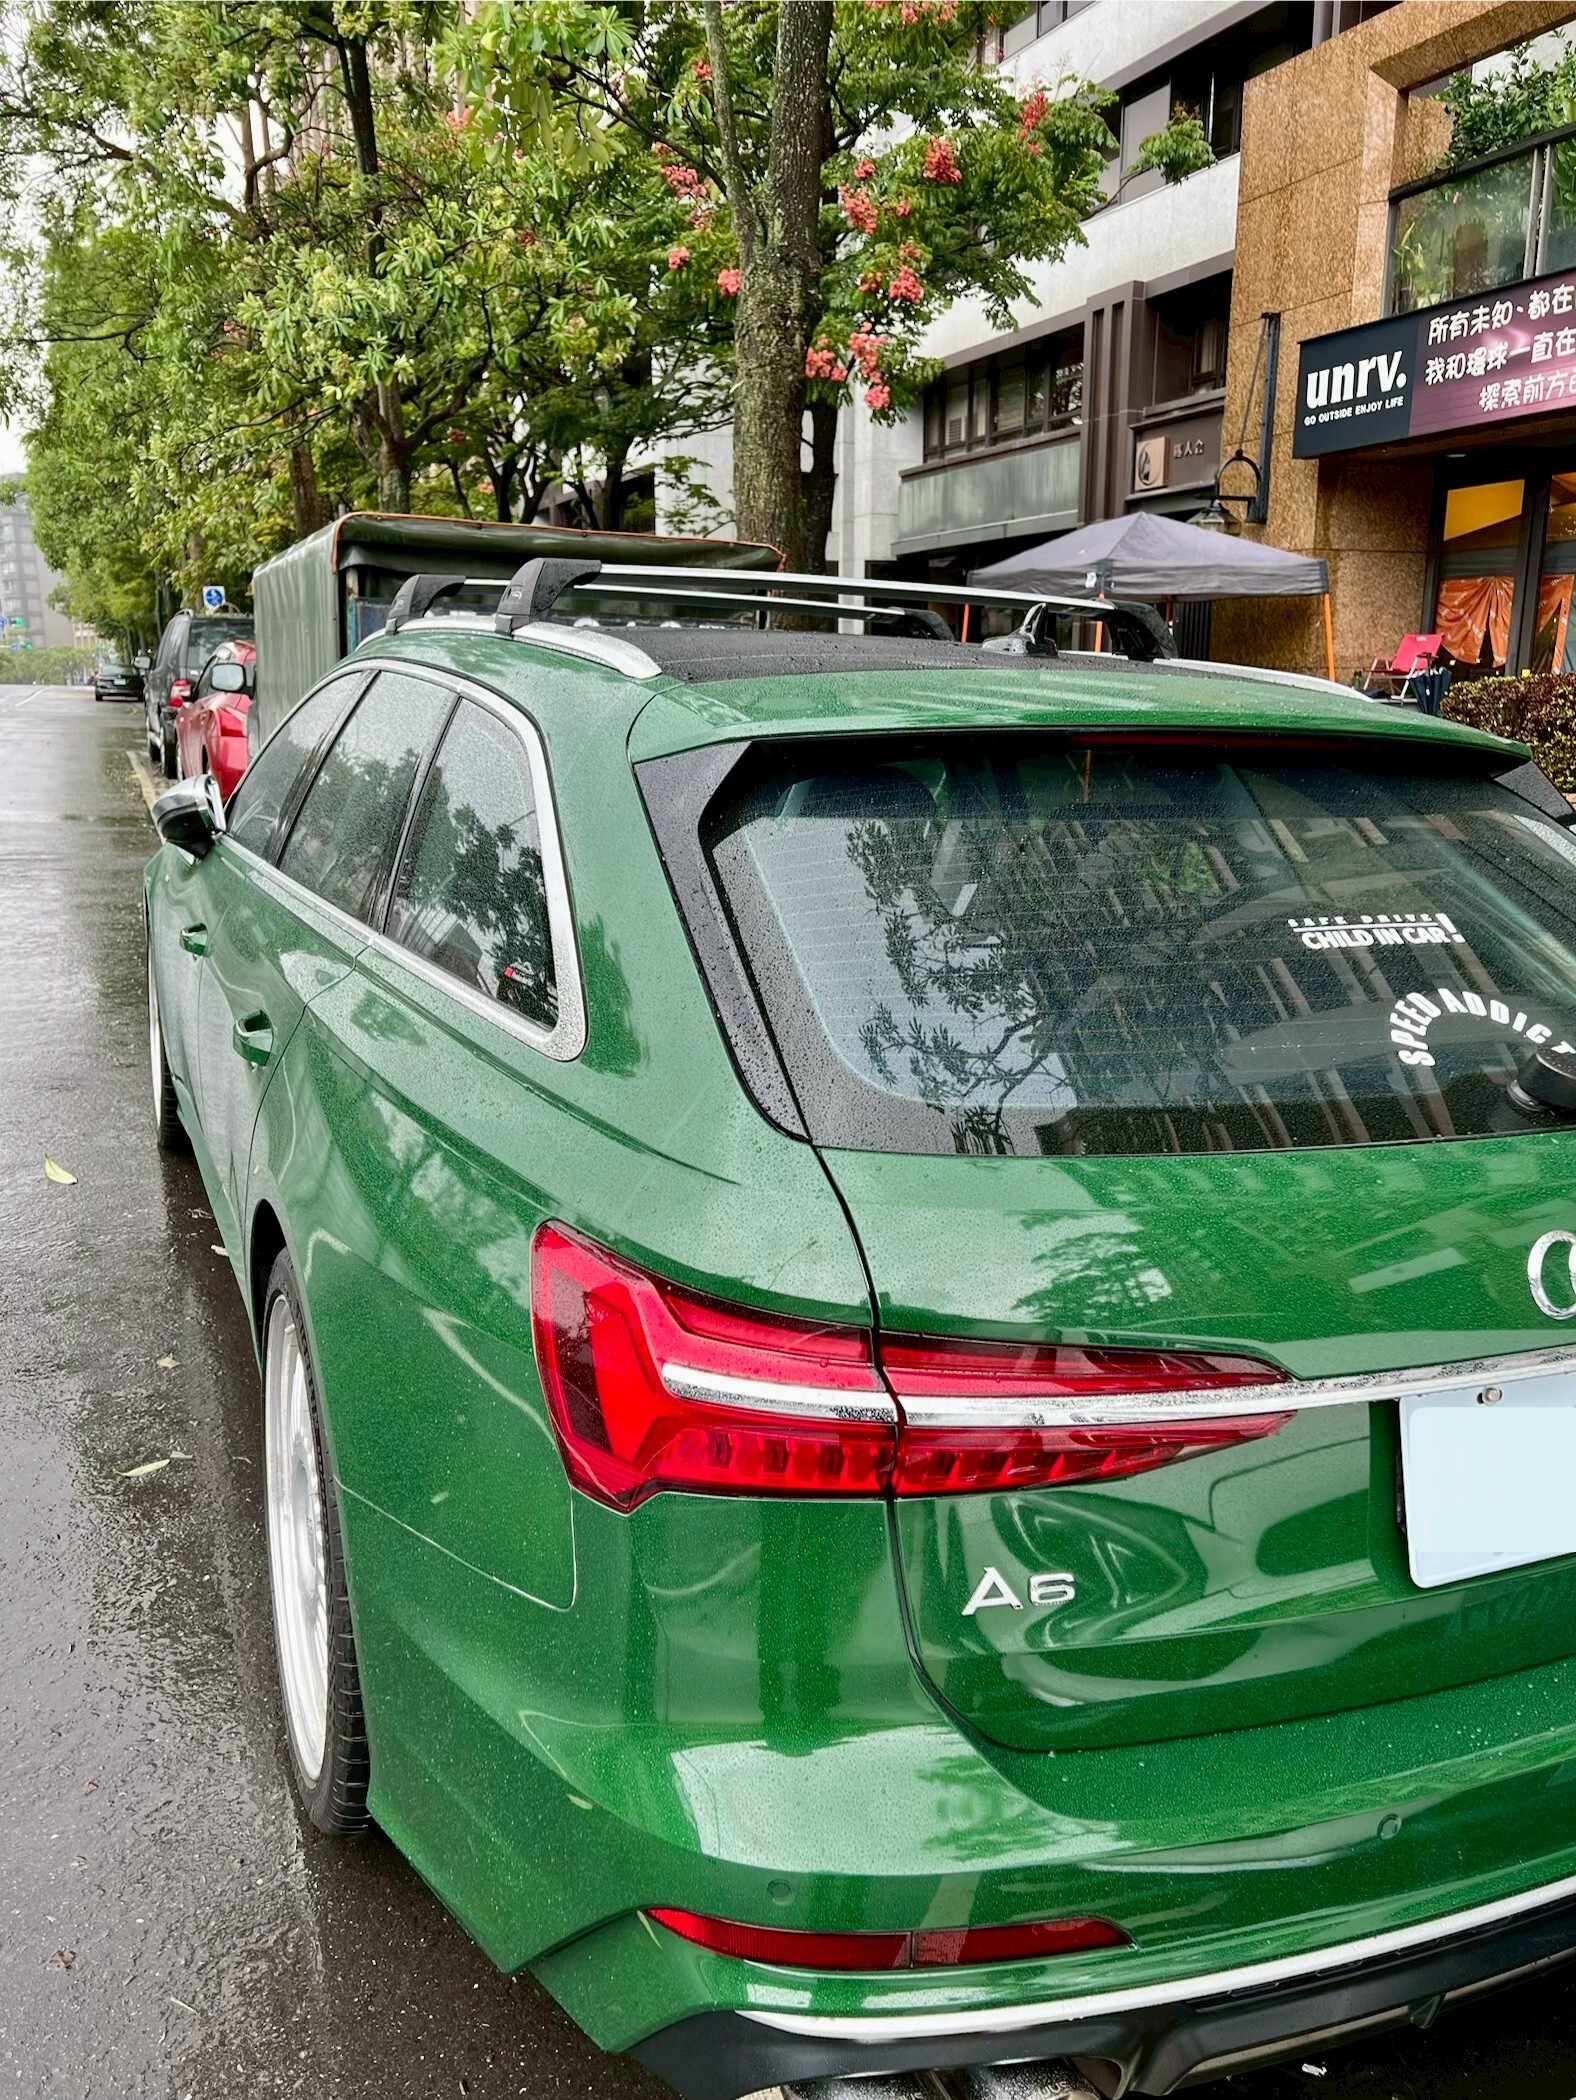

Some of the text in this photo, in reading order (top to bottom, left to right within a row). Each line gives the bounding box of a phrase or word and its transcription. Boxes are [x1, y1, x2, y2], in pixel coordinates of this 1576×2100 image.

[1428, 283, 1576, 346] 所有未知、都在
[1306, 350, 1407, 409] unrv.
[1304, 396, 1404, 426] GO OUTSIDE ENJOY LIFE
[1302, 929, 1375, 950] CHILD
[1372, 928, 1405, 945] IN
[1360, 913, 1433, 924] DRIVE
[1389, 992, 1442, 1067] SPEED
[961, 1566, 1076, 1616] A6
